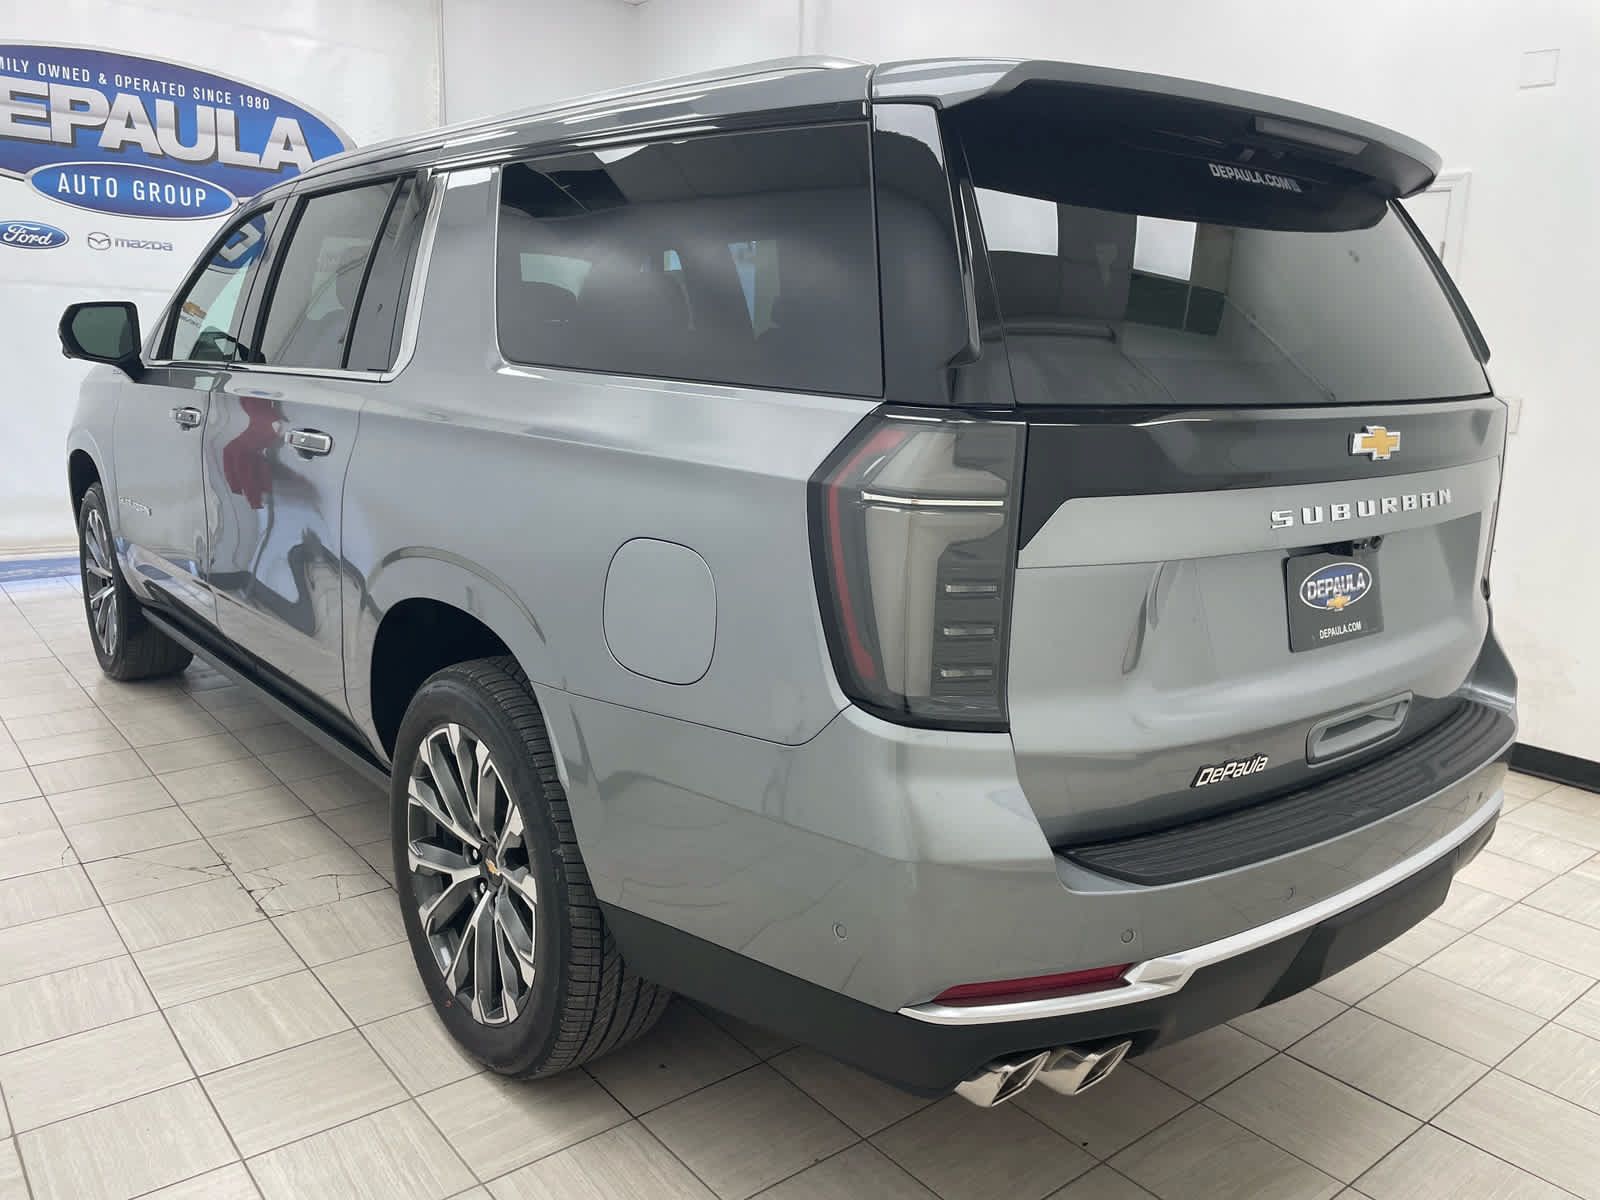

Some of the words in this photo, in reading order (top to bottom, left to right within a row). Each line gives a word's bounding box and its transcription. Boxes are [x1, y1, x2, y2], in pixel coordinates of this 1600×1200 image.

[38, 62, 90, 83] OWNED
[98, 72, 108, 86] &
[115, 73, 186, 98] OPERATED
[193, 86, 232, 106] SINCE
[239, 94, 270, 112] 1980
[57, 172, 118, 198] AUTO
[133, 179, 207, 208] GROUP
[2, 223, 53, 247] Ford
[114, 236, 174, 252] mazda
[1270, 488, 1452, 529] SUBURBAN
[1307, 571, 1366, 601] DEPAULA
[1319, 620, 1362, 640] DEPAULA.COM
[1193, 755, 1269, 788] DePaula
